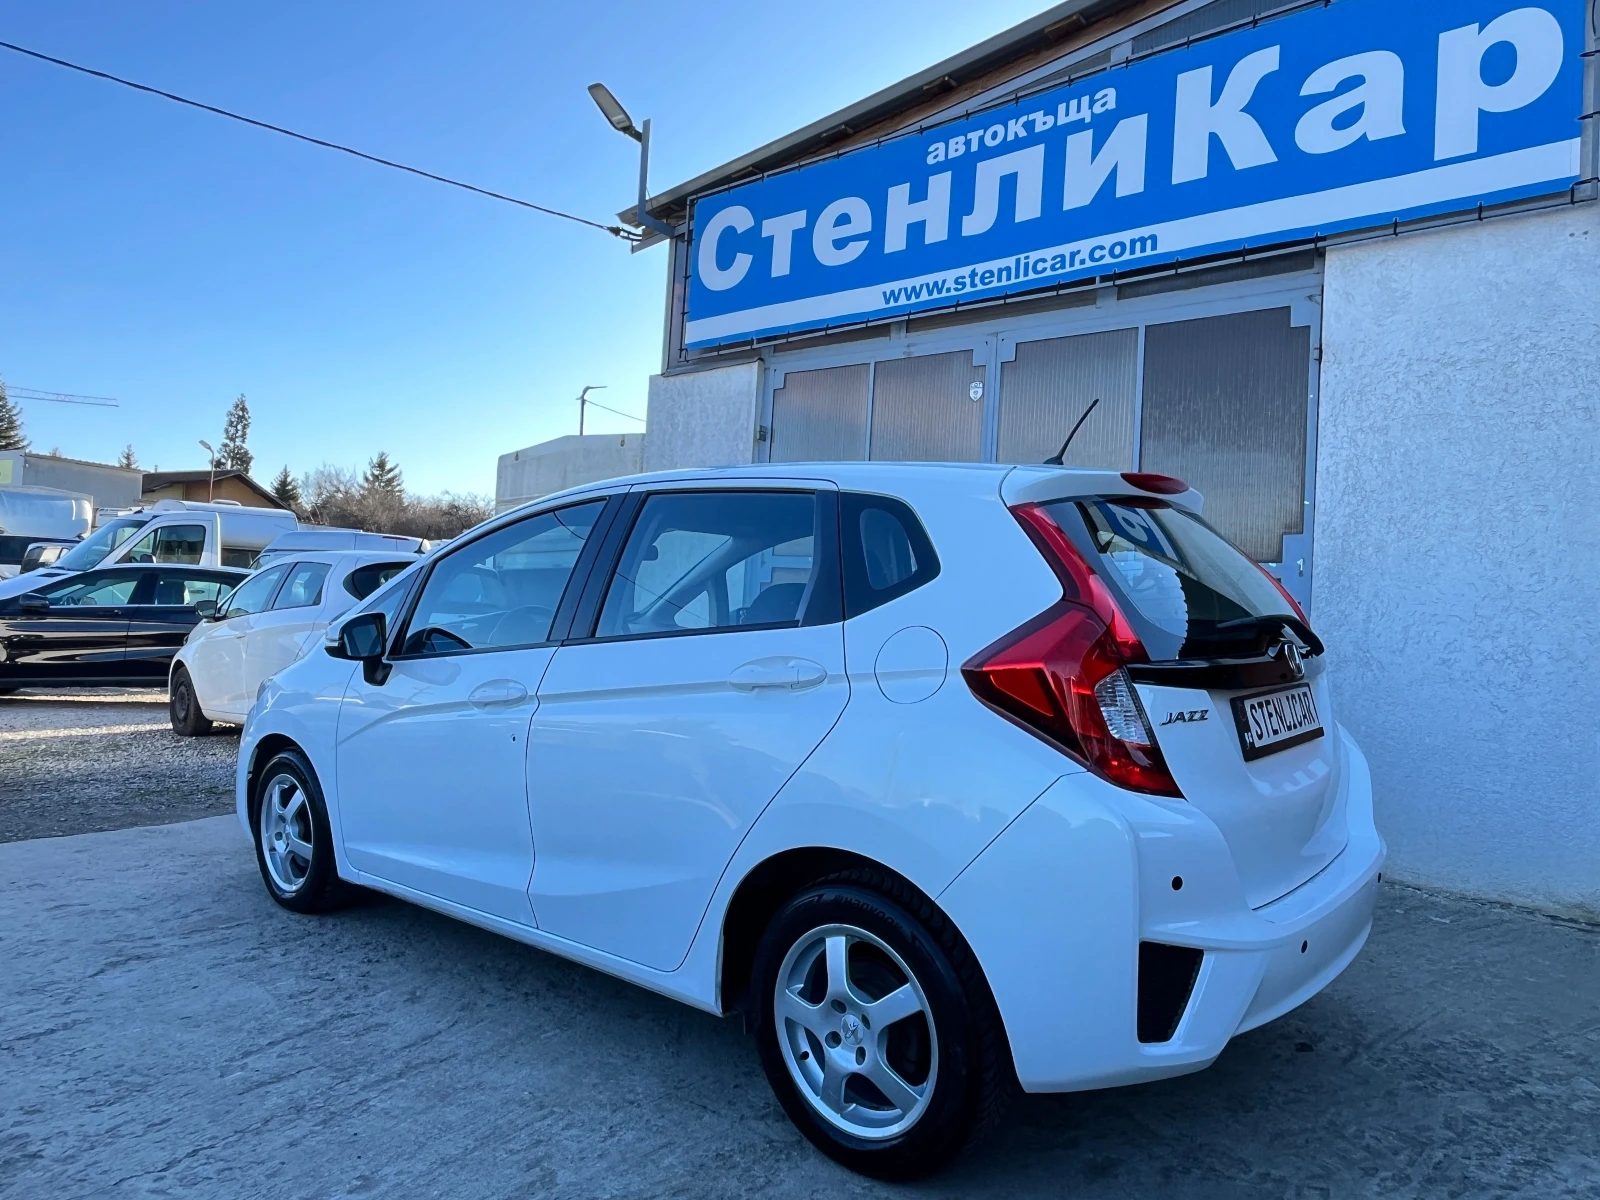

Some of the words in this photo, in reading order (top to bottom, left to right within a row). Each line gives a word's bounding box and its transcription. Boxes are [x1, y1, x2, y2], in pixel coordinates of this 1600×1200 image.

[697, 6, 1564, 292] СтенлиКар
[926, 87, 1117, 165] автокъща
[882, 233, 1158, 306] www.stenlicar.com
[1159, 709, 1209, 726] JAZZ
[1249, 691, 1317, 741] STENLICAR
